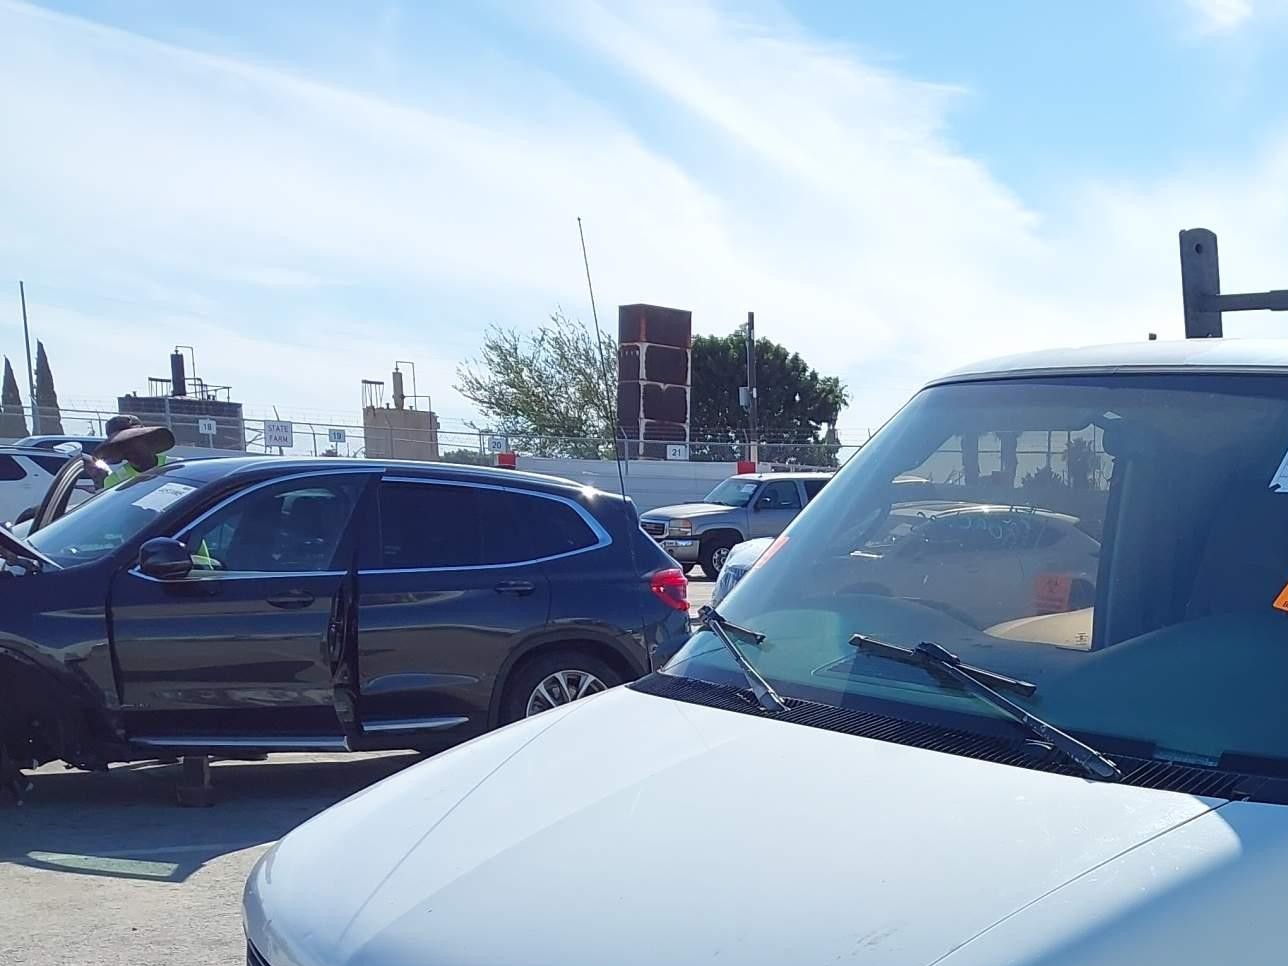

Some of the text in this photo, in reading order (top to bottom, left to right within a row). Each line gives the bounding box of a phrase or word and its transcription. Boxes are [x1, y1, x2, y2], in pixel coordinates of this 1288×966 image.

[202, 423, 212, 431] 18
[268, 425, 289, 433] STATE
[333, 431, 342, 440] 19
[491, 440, 502, 449] 20
[671, 448, 682, 457] 21
